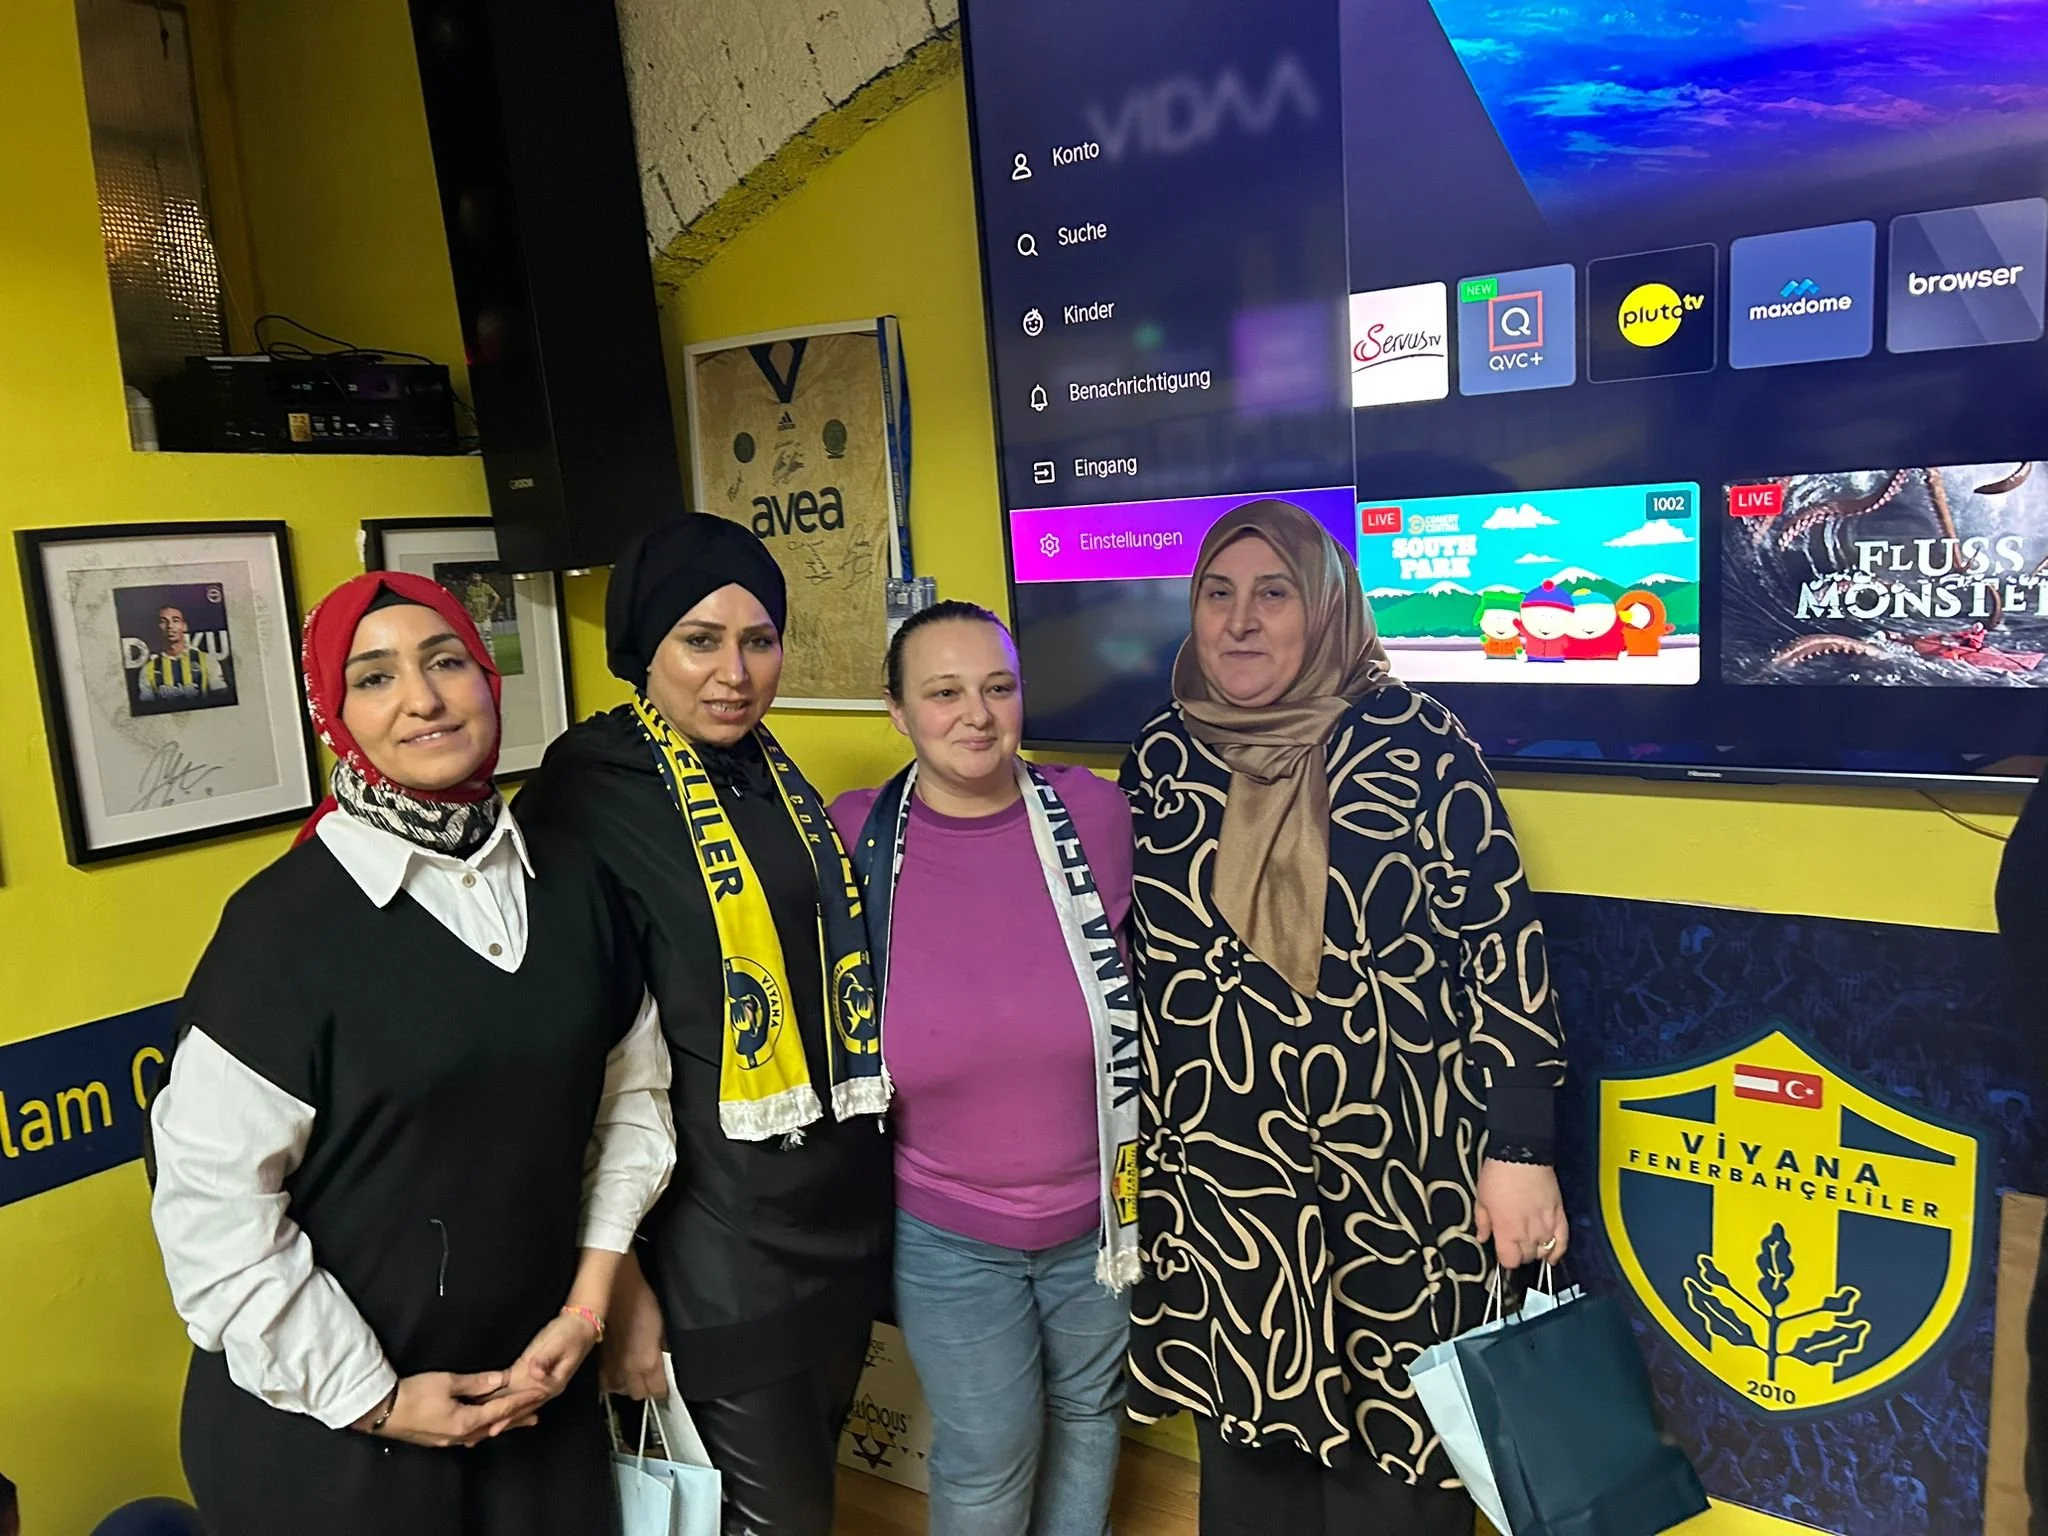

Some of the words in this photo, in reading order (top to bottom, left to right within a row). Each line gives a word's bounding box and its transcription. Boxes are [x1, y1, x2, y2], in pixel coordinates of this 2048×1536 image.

[1052, 141, 1100, 167] Konto
[1058, 221, 1108, 246] Suche
[1466, 284, 1492, 297] NEW
[1908, 264, 2024, 295] browser
[1064, 300, 1115, 325] Kinder
[1501, 306, 1531, 336] Q
[1623, 302, 1684, 328] pluto
[1682, 293, 1705, 312] tv
[1749, 295, 1852, 321] maxdome
[1489, 351, 1544, 371] QVC+
[1069, 368, 1211, 401] Benachrichtigung
[1074, 455, 1138, 478] Eingang
[751, 486, 845, 539] avea
[1653, 496, 1685, 511] 1002
[1738, 491, 1773, 508] LIVE
[1367, 512, 1396, 527] LIVE
[1080, 529, 1183, 551] Einstellungen
[1391, 534, 1478, 560] SOUTH
[1400, 557, 1472, 580] PARK
[1854, 535, 2025, 577] FLUSS
[1680, 1131, 1881, 1188] VİYANA
[1629, 1149, 1940, 1219] FENERBAHÇELİLER
[1746, 1379, 1796, 1405] 2010
